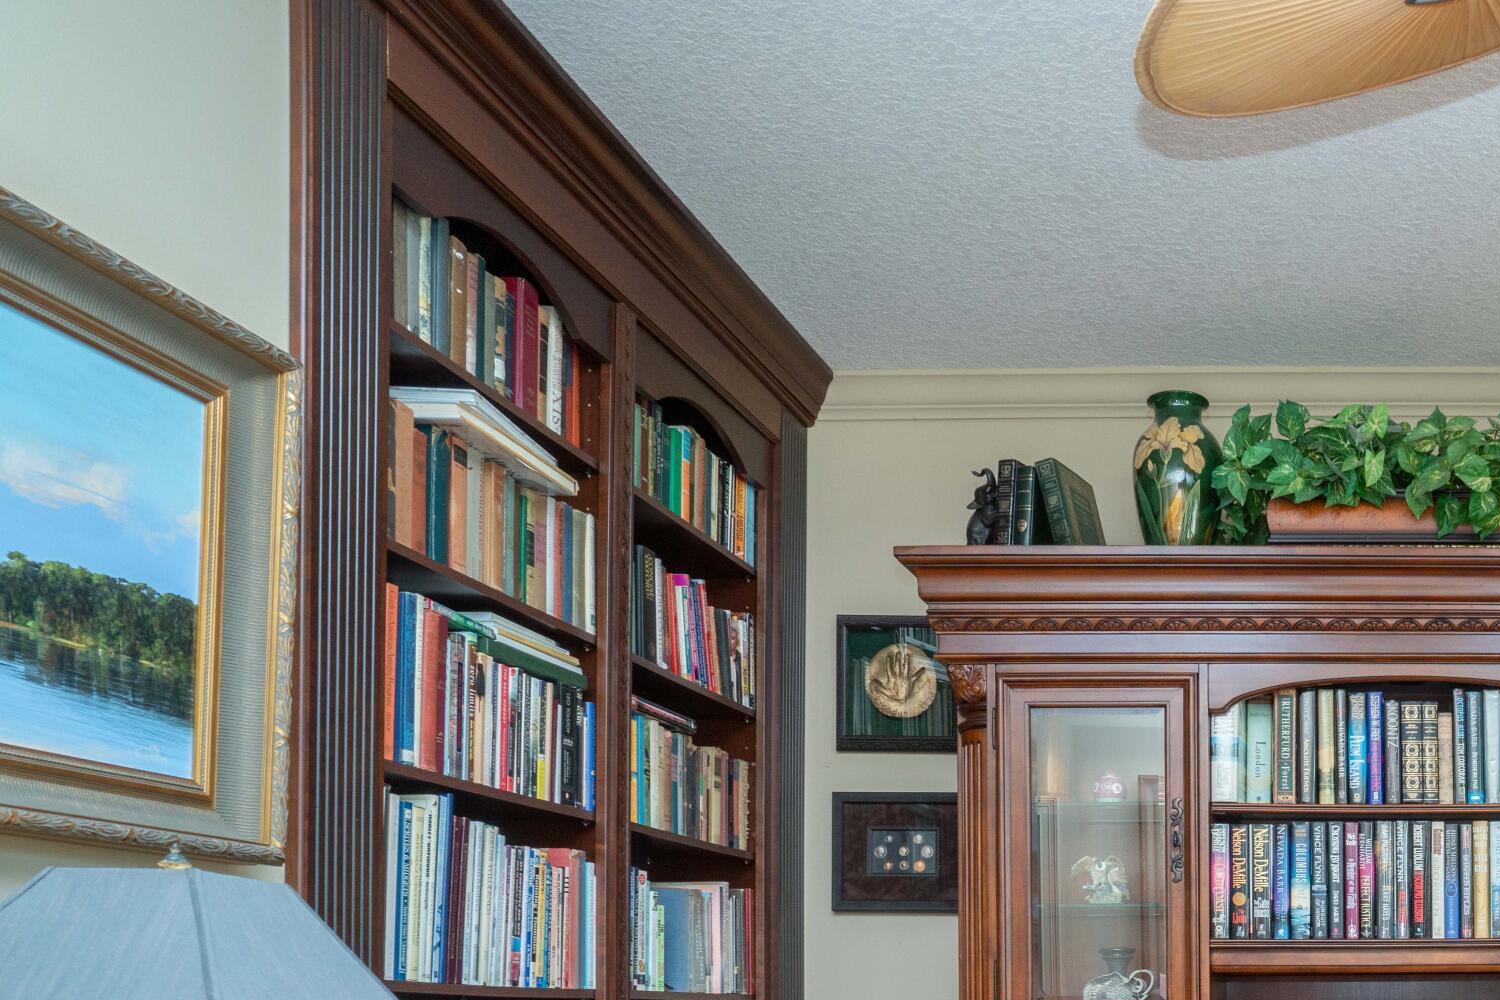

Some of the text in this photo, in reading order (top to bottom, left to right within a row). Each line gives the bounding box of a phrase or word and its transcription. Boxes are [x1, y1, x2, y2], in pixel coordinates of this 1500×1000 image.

[1281, 701, 1291, 791] RUTHERFURD Forest
[1388, 708, 1399, 748] KOONTZ
[1256, 741, 1267, 778] London
[1232, 828, 1247, 889] Nelson DeMille
[1254, 828, 1269, 893] Nelson DeMille
[1276, 827, 1286, 894] NEVADA BARR
[1295, 843, 1308, 884] COLUMBUS
[1314, 825, 1322, 884] VINCE FLYNN
[1331, 825, 1341, 884] CROSSING BY NIGHT
[1396, 825, 1404, 854] VINCE
[1413, 824, 1423, 872] ROBERT LUDLUM
[1396, 855, 1404, 883] FLYNN
[1361, 875, 1371, 928] PERFECT JUSTICE
